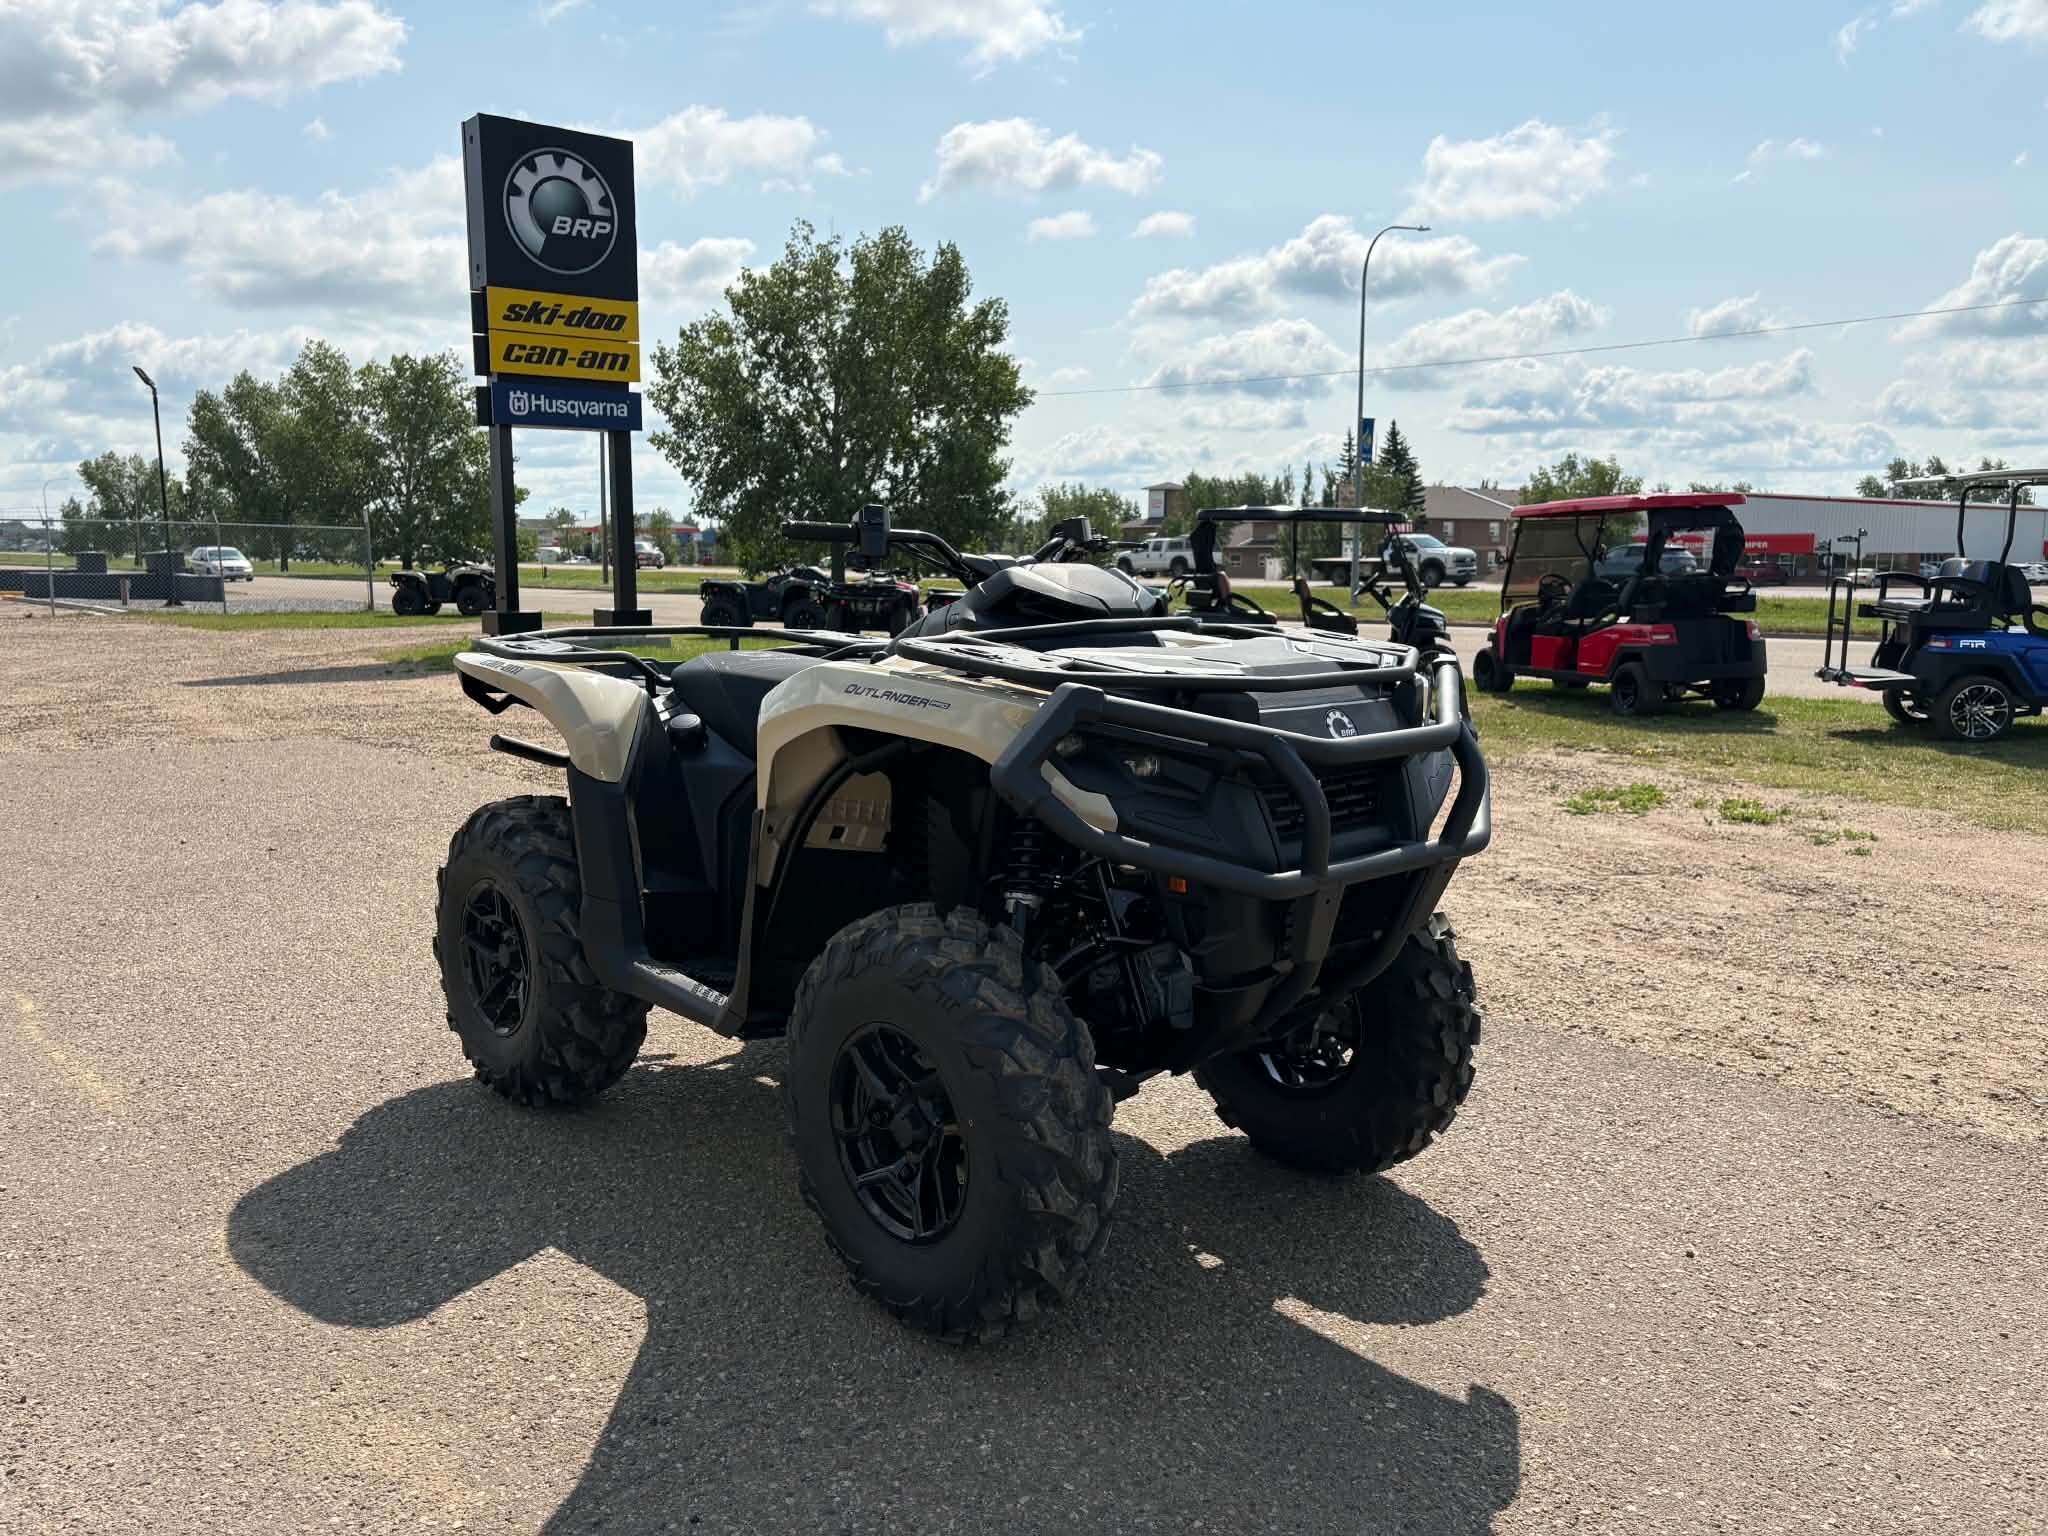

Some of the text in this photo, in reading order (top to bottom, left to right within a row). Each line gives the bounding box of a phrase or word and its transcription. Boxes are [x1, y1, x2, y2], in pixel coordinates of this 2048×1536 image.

[551, 215, 611, 239] BRP
[502, 301, 626, 333] ski-doo
[502, 343, 629, 372] can-am
[531, 394, 629, 417] Husqvarna
[844, 684, 929, 708] OUTLANDER
